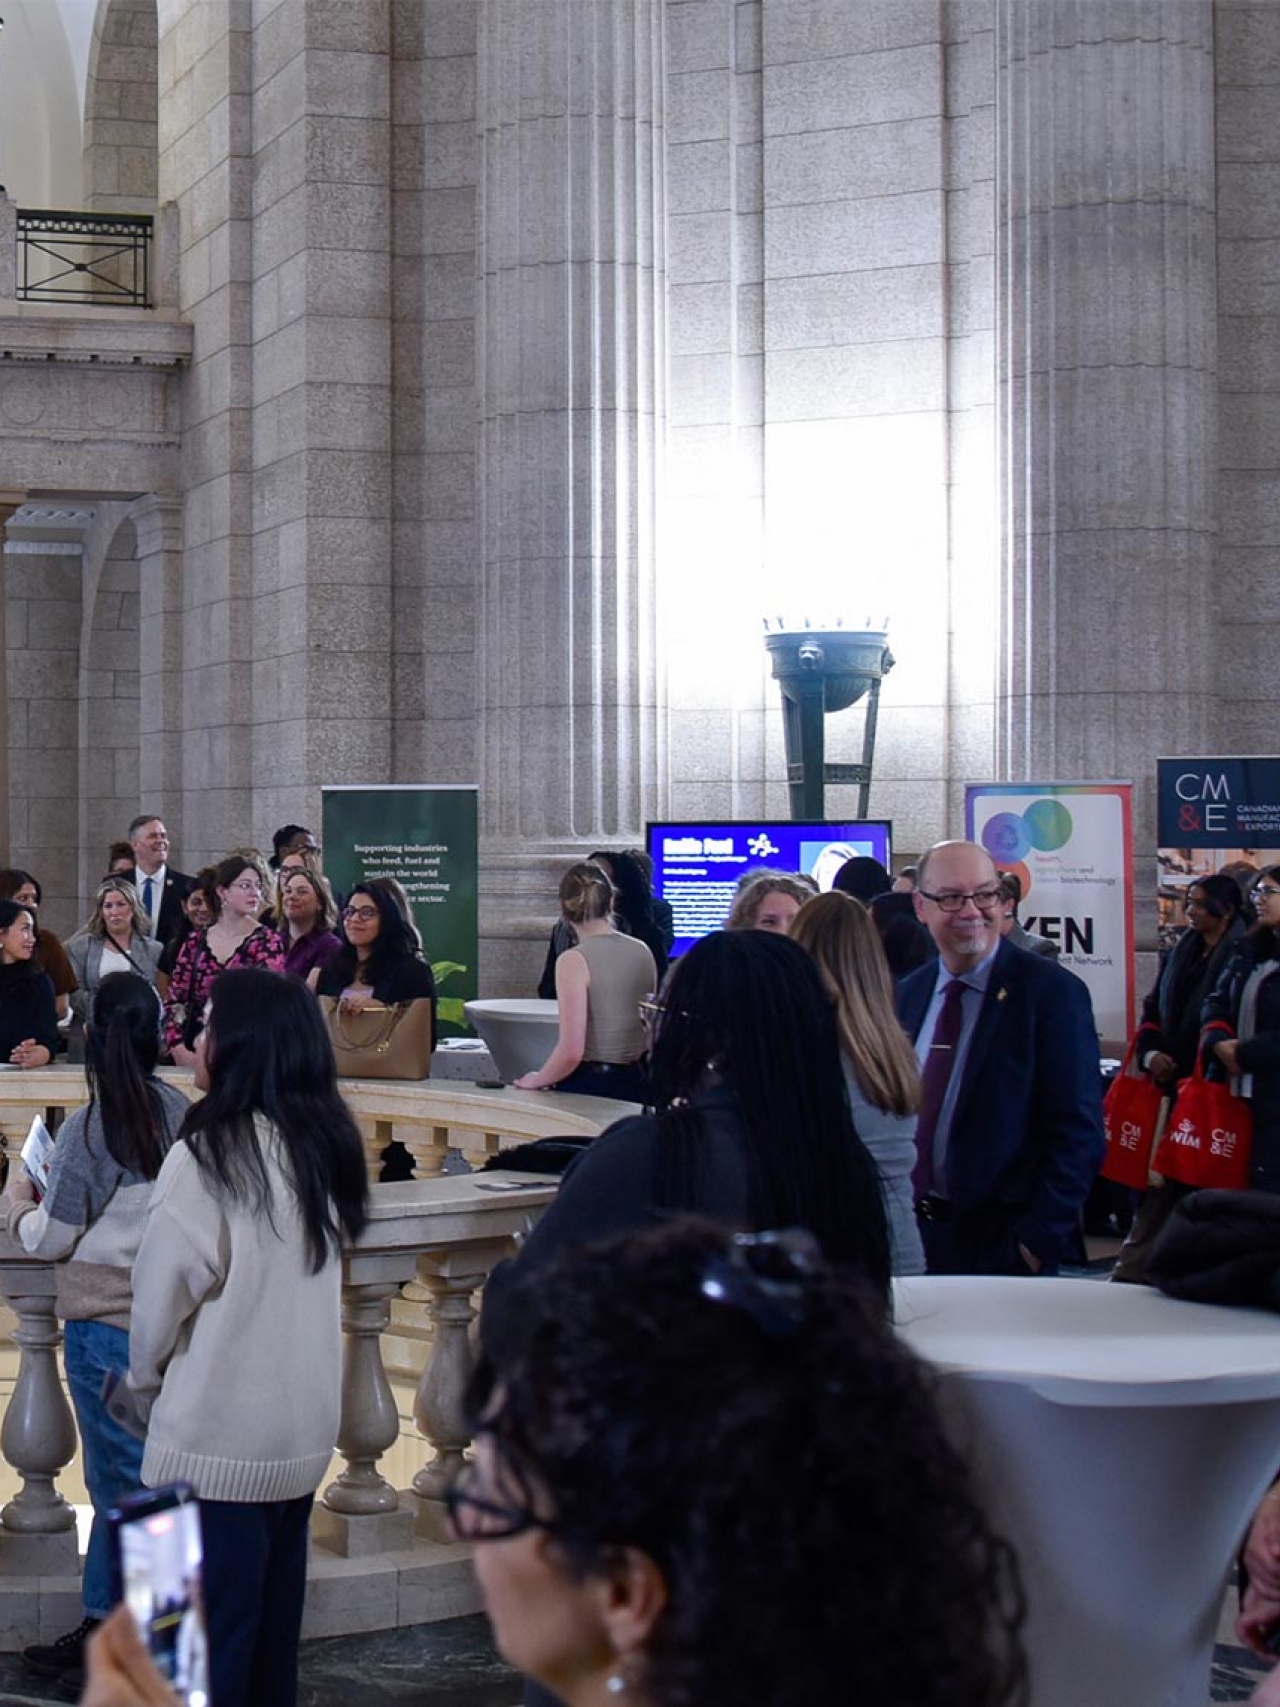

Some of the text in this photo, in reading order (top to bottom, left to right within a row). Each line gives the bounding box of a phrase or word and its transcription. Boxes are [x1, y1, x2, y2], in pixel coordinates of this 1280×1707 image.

[1175, 773, 1231, 801] CM
[1236, 804, 1280, 812] CANADIA
[354, 844, 448, 853] Supporting industries
[382, 857, 403, 865] feed,
[364, 869, 438, 877] sustain the world
[1060, 875, 1116, 887] biotechnology
[1074, 955, 1114, 967] Network
